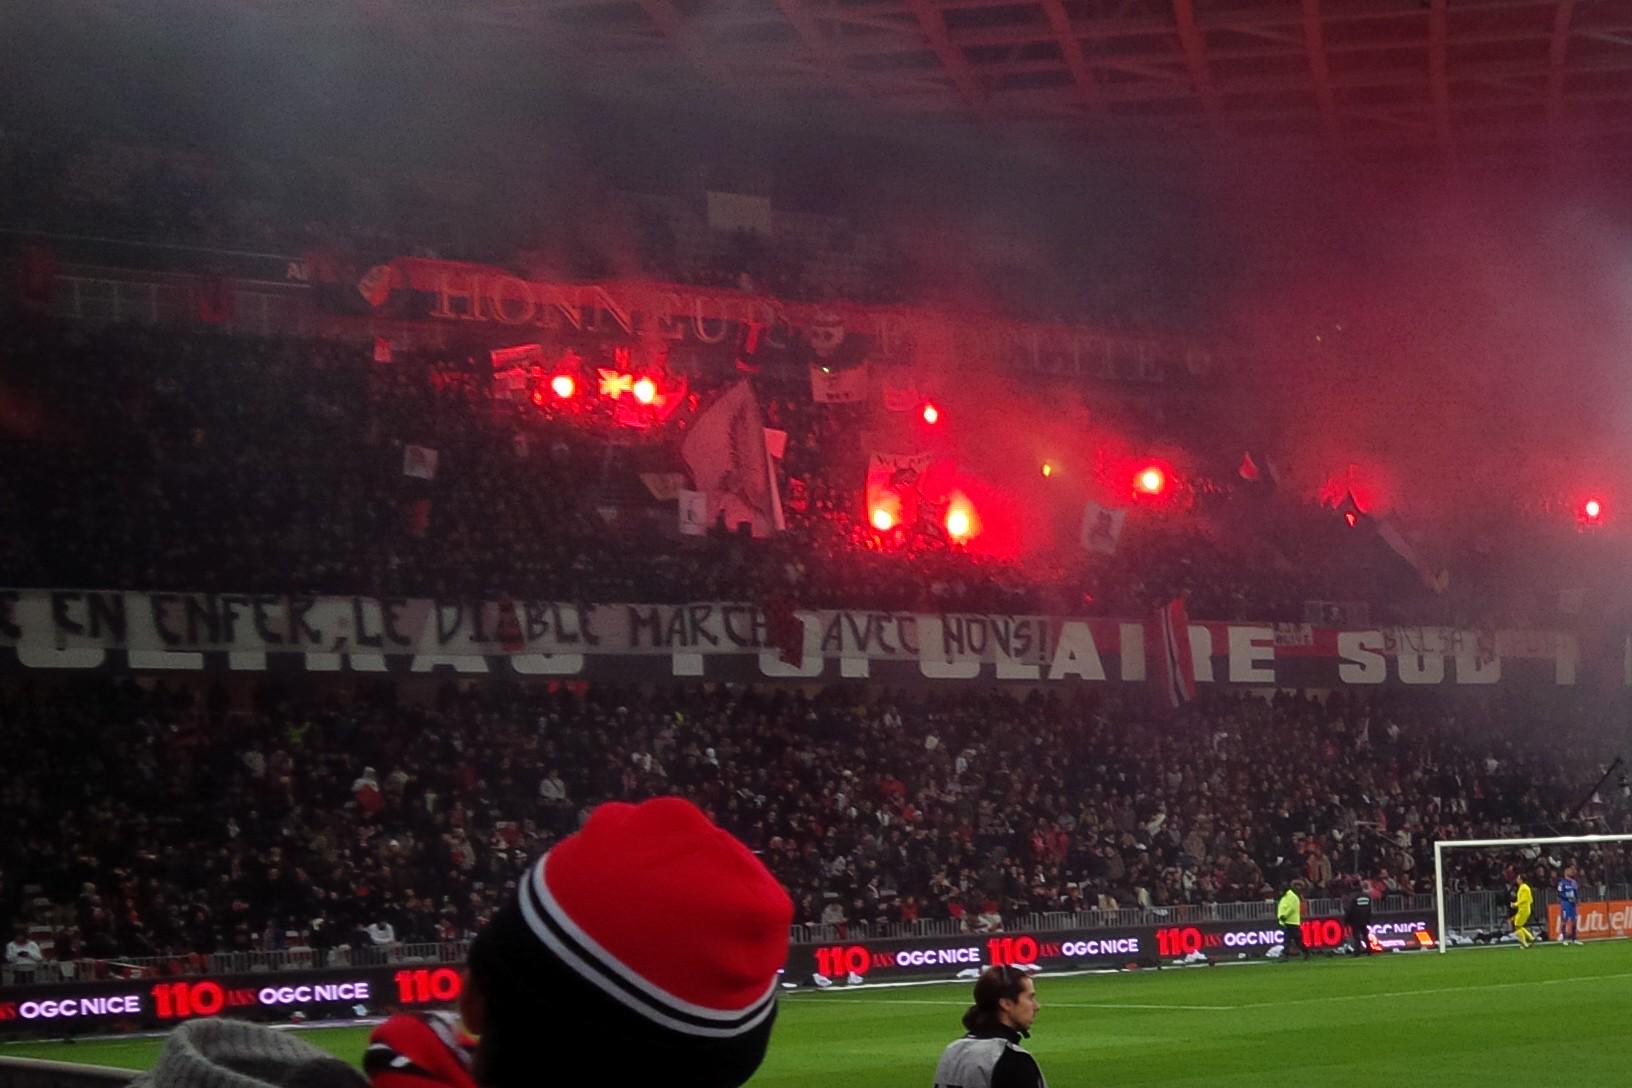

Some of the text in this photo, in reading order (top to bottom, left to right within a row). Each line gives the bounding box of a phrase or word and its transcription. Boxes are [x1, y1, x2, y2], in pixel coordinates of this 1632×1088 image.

[51, 592, 126, 641] EN
[627, 603, 769, 649] MARCH
[820, 614, 921, 652] AVEC
[1156, 927, 1205, 957] 110
[1224, 931, 1258, 947] OGC
[1259, 929, 1284, 945] NIC
[1302, 919, 1344, 948] 110
[814, 944, 871, 976] 110
[896, 949, 937, 966] OGC
[938, 947, 981, 964] NICE
[988, 935, 1040, 966] 110
[1062, 940, 1100, 957] OGC
[1101, 937, 1139, 955] NICE
[151, 979, 225, 1020] 110
[258, 985, 312, 1006] OGC
[314, 982, 370, 1001] NICE
[395, 966, 463, 1003] 110
[19, 1000, 78, 1020] OGC
[80, 995, 142, 1016] NICE
